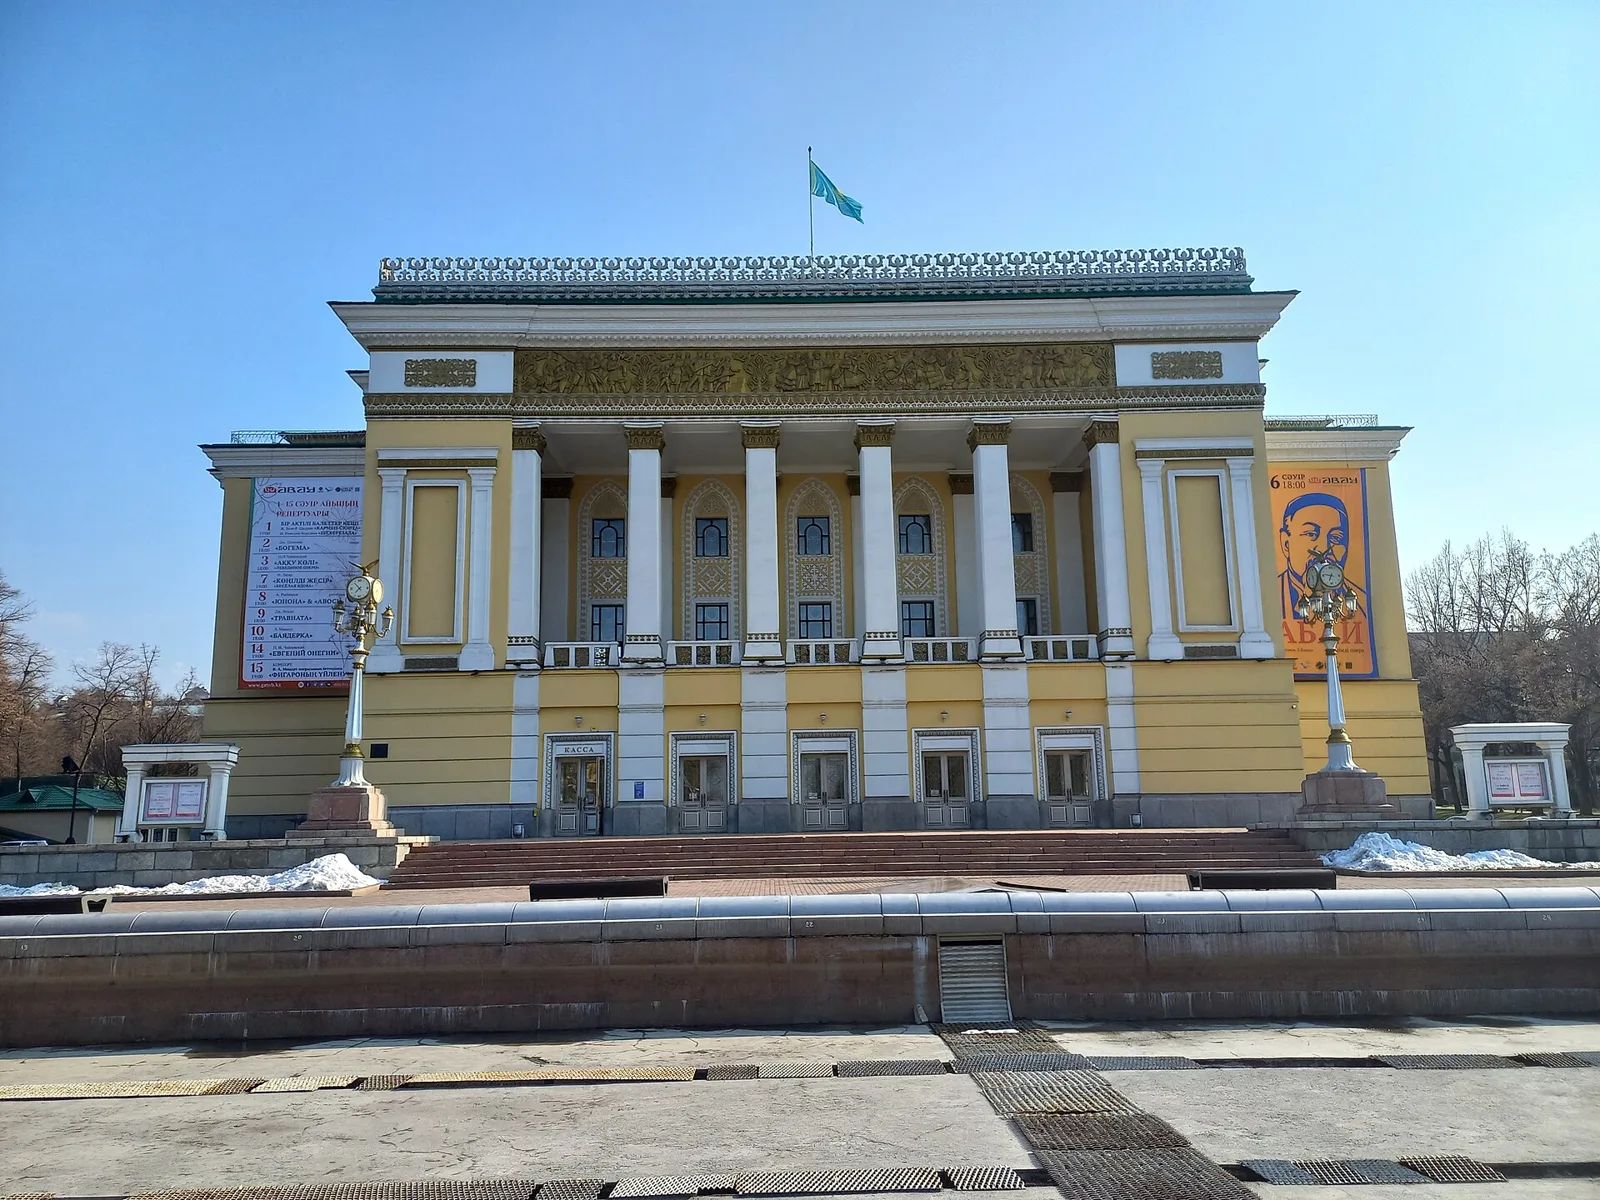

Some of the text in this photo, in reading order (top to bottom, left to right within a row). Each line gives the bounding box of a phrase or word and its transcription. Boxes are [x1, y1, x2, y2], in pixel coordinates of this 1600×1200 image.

[1270, 475, 1280, 489] 6
[267, 522, 271, 531] 1
[263, 538, 270, 547] 2
[261, 556, 269, 565] 3
[261, 574, 268, 583] 7
[259, 591, 266, 601] 8
[258, 609, 265, 618] 9
[251, 626, 264, 636] 10
[251, 643, 264, 654] 14
[251, 662, 264, 673] 15
